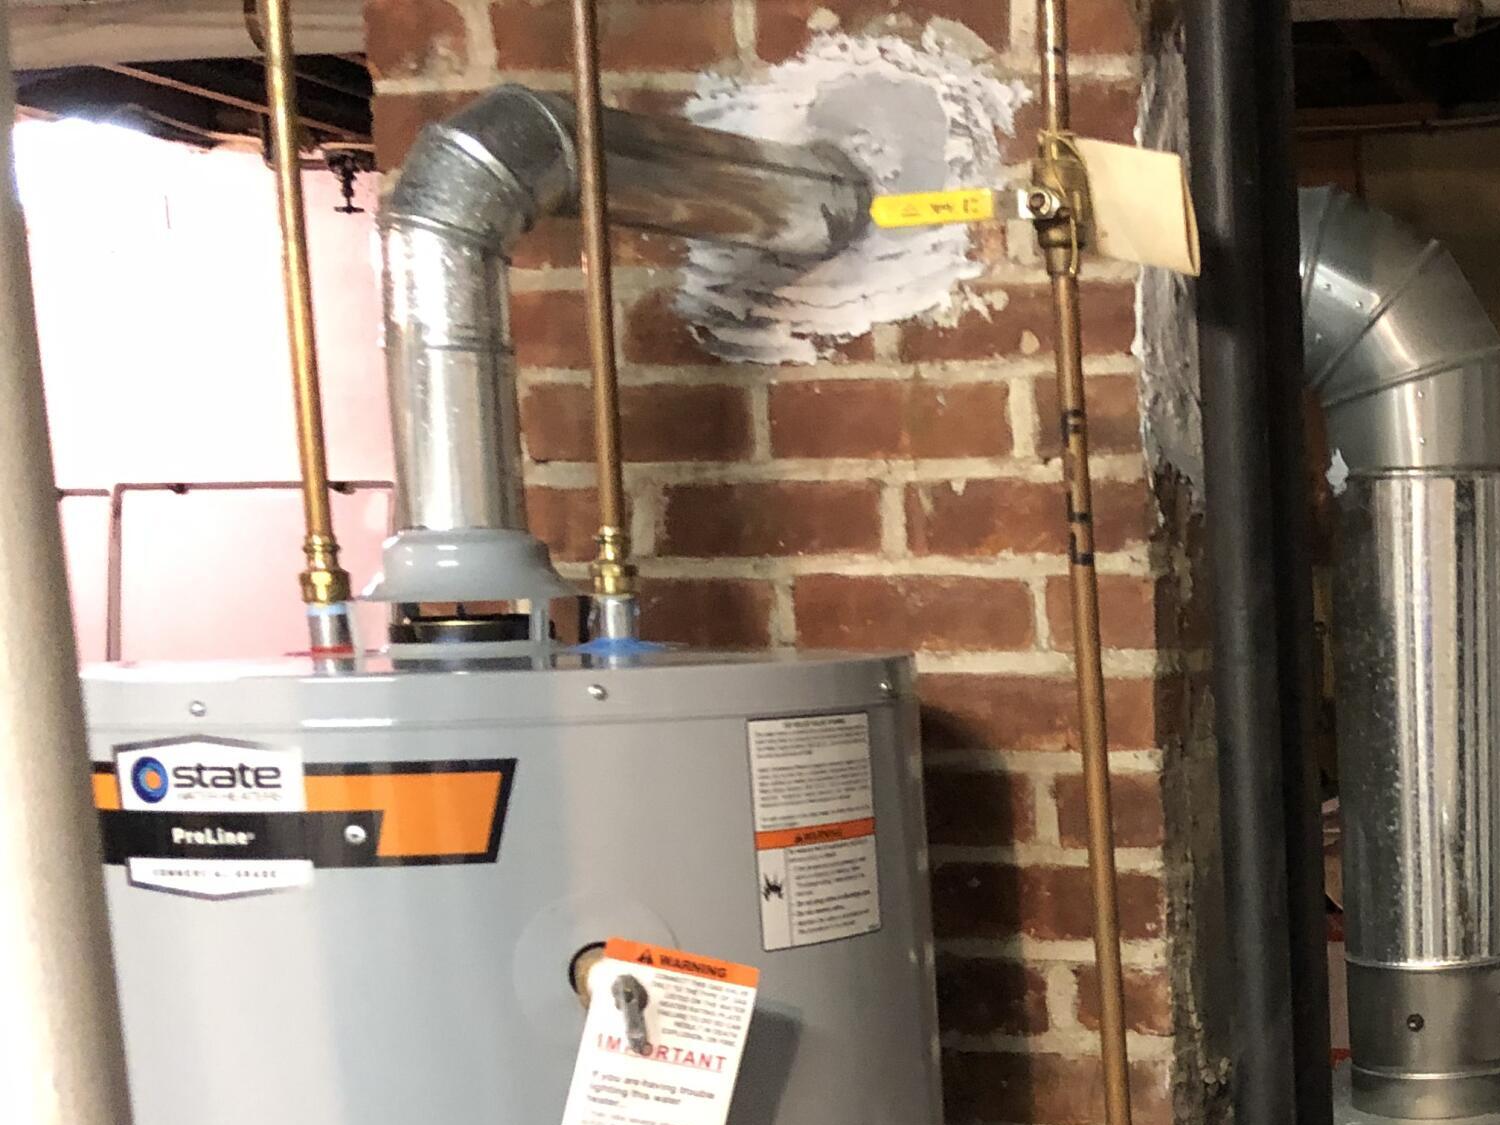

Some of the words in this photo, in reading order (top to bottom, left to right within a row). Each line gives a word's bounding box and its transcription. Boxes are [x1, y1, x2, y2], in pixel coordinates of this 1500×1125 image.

[172, 762, 282, 789] state
[659, 953, 728, 979] WARNING
[597, 1033, 727, 1073] IMORTANT
